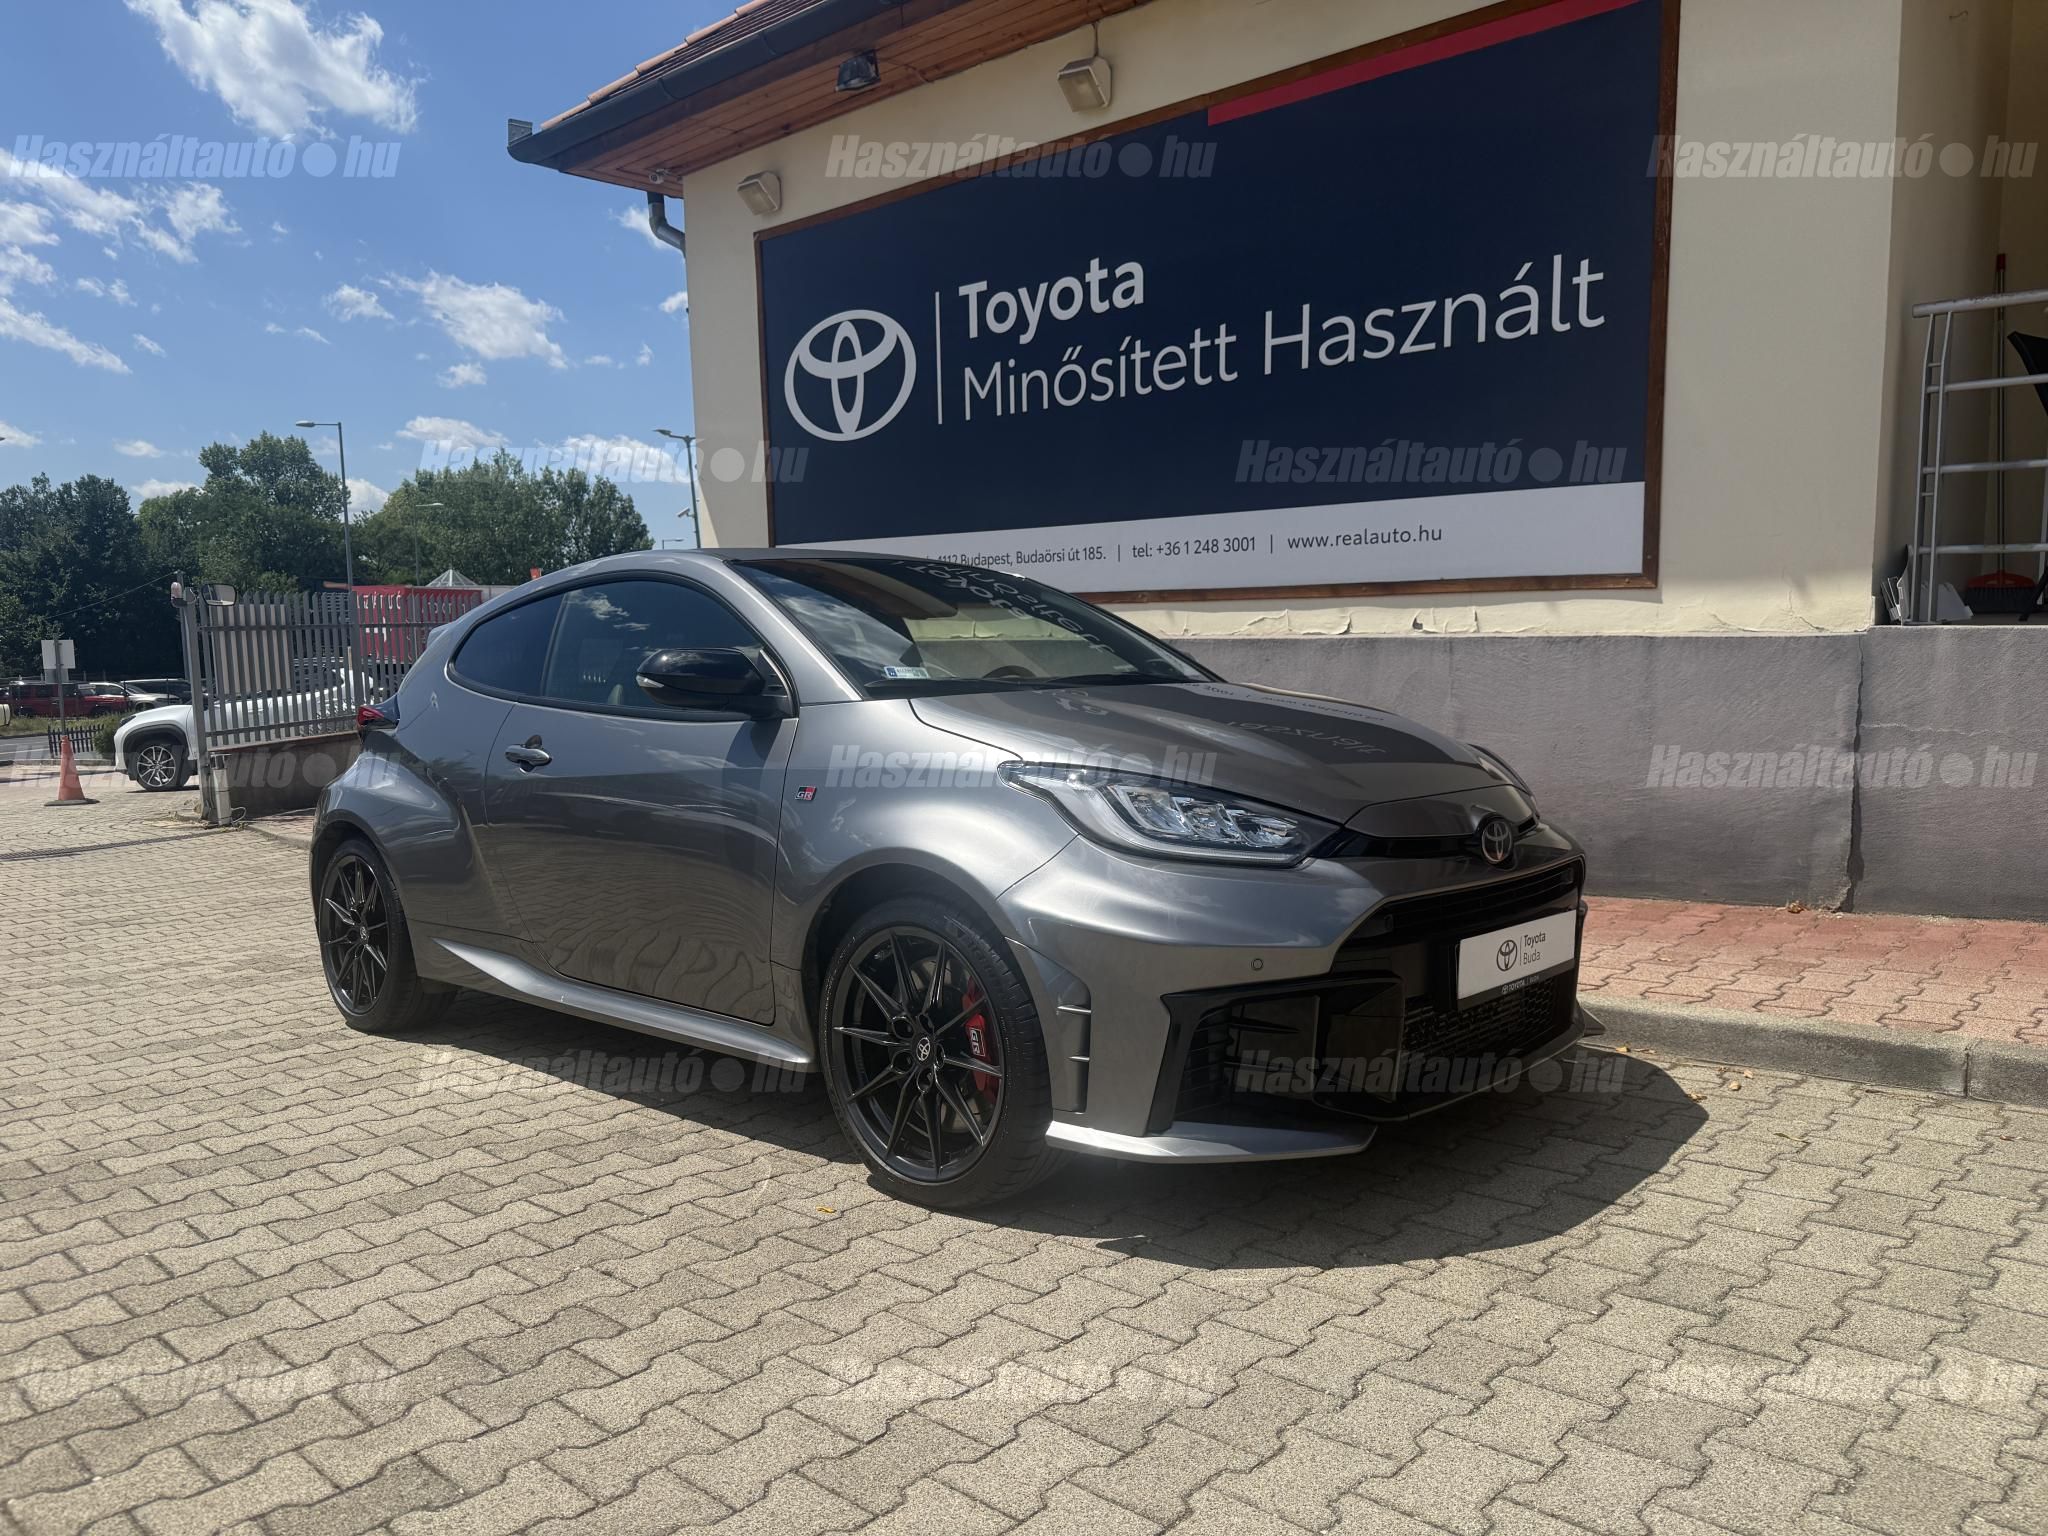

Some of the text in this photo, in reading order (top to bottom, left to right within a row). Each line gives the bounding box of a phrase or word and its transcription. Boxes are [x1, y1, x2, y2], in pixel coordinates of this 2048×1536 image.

[958, 257, 1145, 345] Toyota
[964, 253, 1606, 421] Minősített Használt
[1016, 547, 1065, 565] Budaörsi
[1067, 546, 1081, 563] út
[1083, 545, 1107, 561] 185.
[1132, 543, 1154, 559] tel:
[1193, 538, 1220, 555] 248
[1223, 535, 1257, 553] 3001
[1287, 524, 1443, 550] www.realauto.hu
[1522, 949, 1541, 965] Buda
[1523, 931, 1546, 948] Toyota
